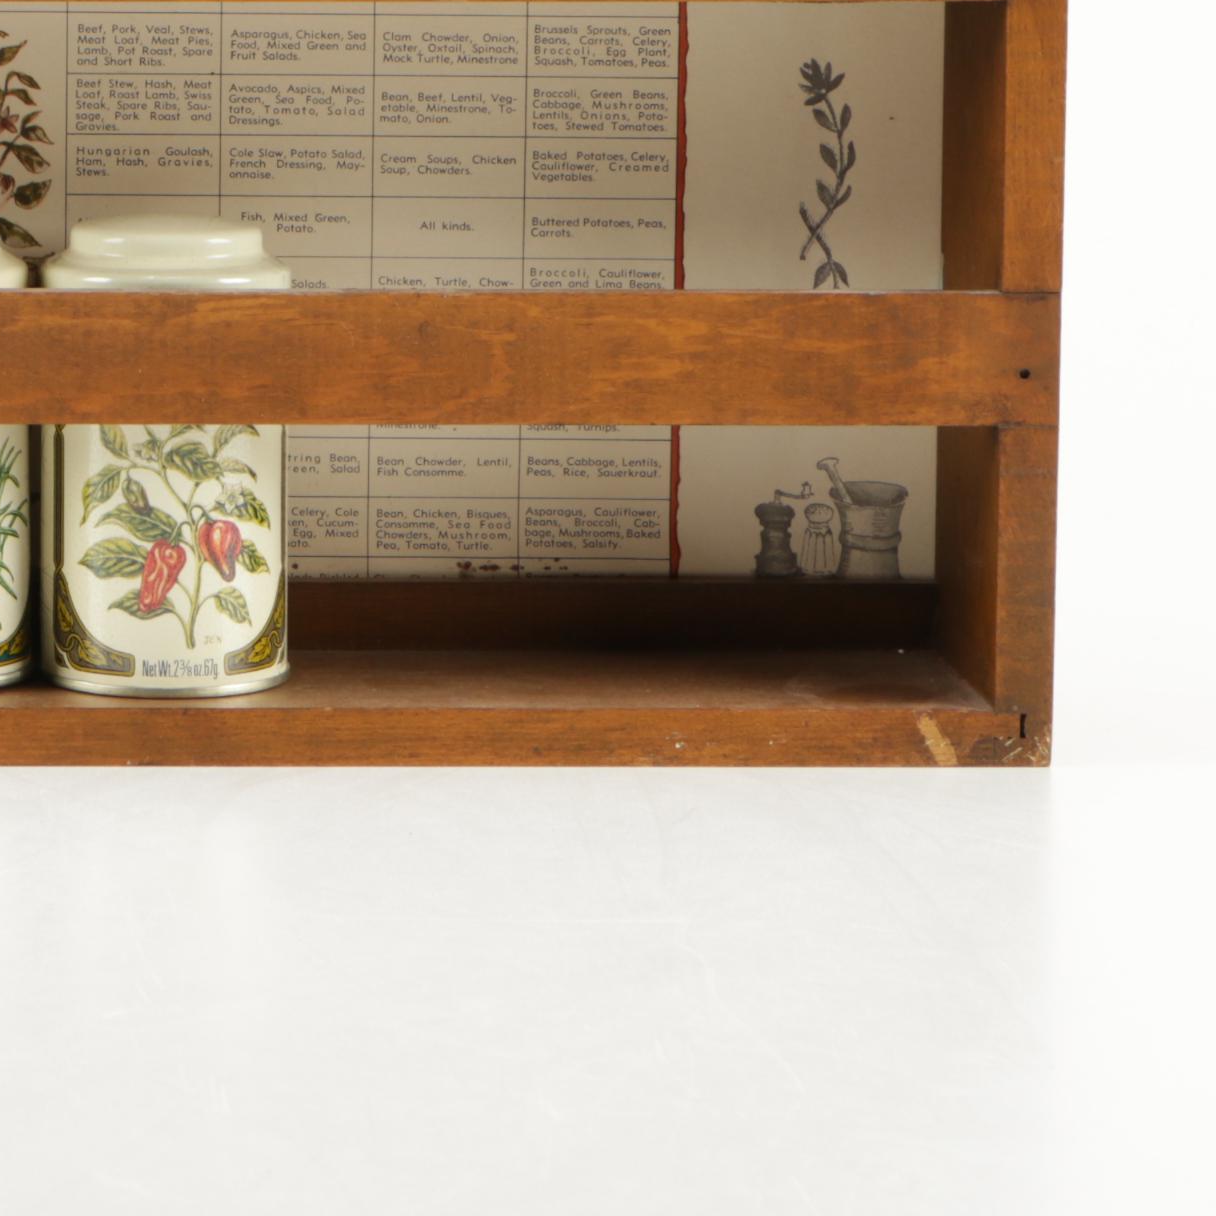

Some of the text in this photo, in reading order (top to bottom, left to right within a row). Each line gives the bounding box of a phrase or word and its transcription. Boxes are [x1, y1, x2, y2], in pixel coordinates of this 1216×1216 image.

[380, 153, 517, 166] Cream Soups, Chicken
[380, 164, 472, 176] Soup, Chowders.
[419, 221, 475, 231] All kinds.
[531, 216, 666, 229] Buttered Potatoes, Peas,
[530, 227, 575, 238] Carrots.
[415, 456, 466, 467] Chowder,
[476, 457, 512, 468] Lentil,
[527, 456, 662, 468] Beans, Cabbage, Lentils,
[376, 466, 399, 476] Fish
[526, 466, 662, 478] Peas, Rice, Sauerkraut.
